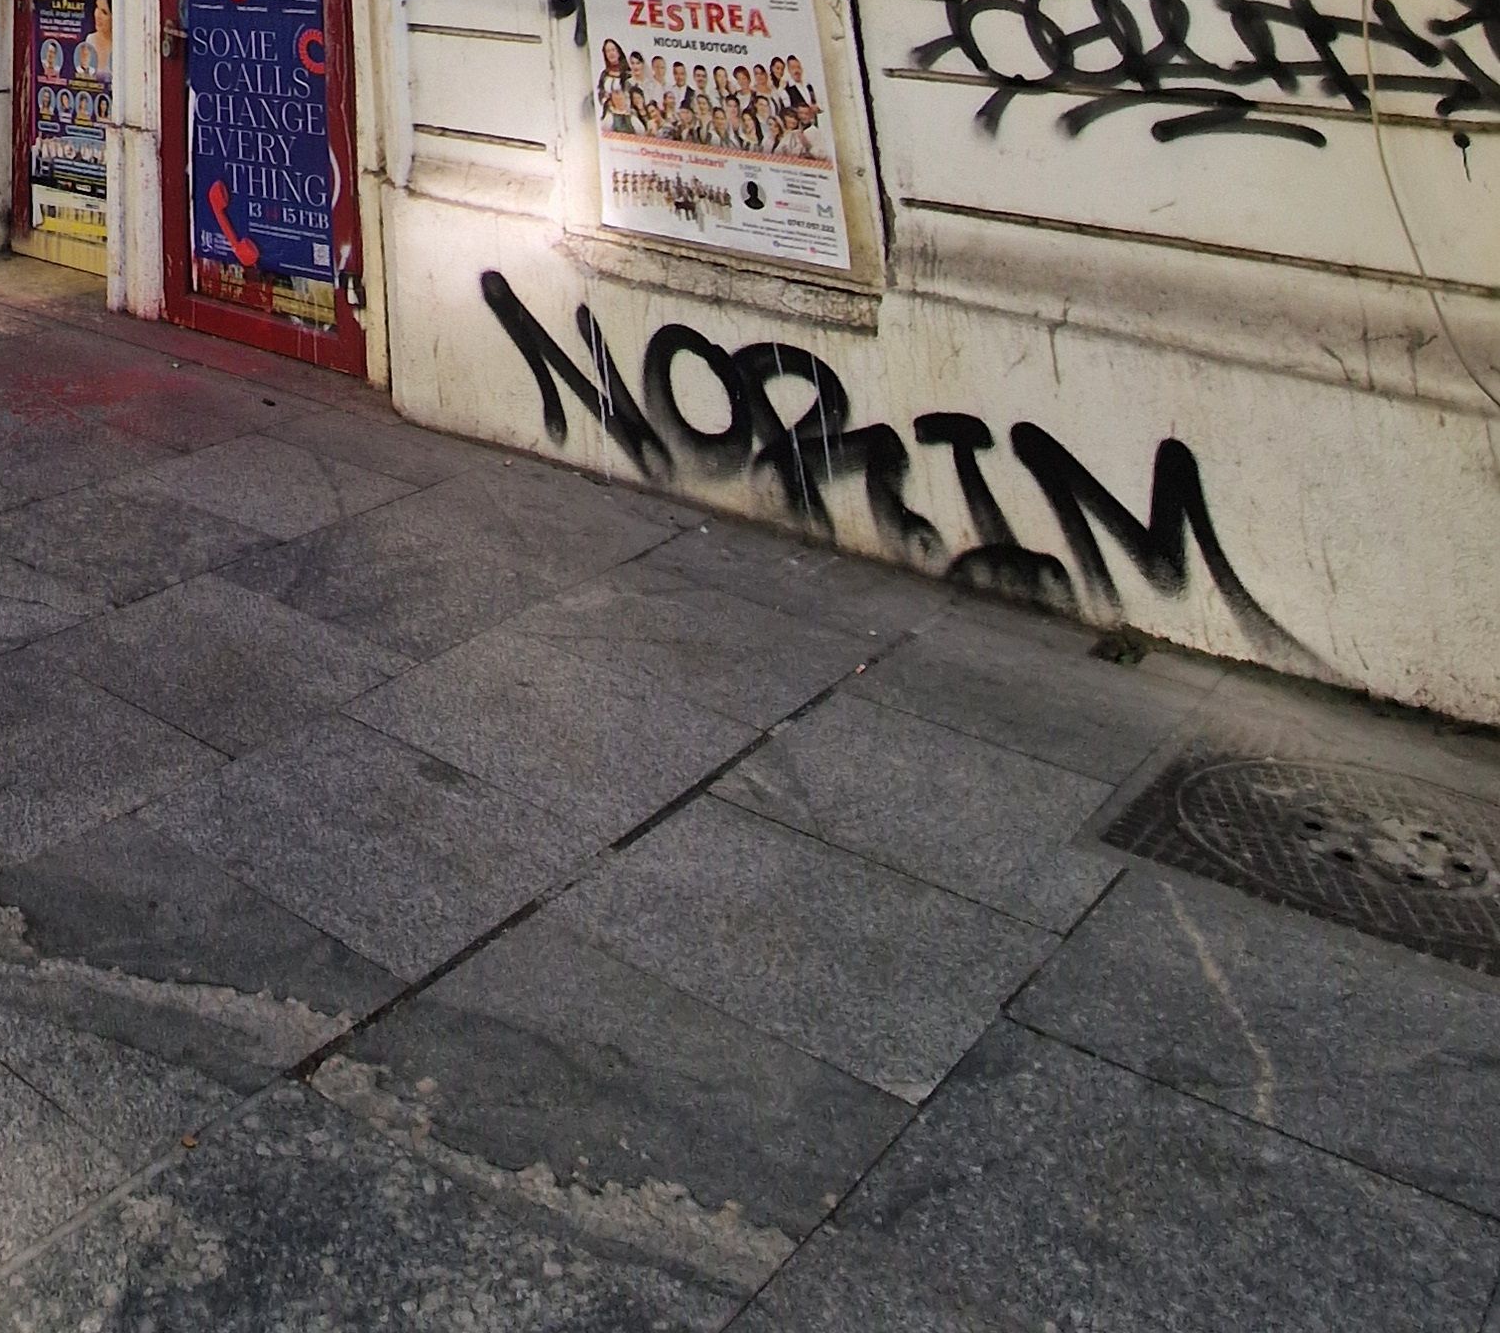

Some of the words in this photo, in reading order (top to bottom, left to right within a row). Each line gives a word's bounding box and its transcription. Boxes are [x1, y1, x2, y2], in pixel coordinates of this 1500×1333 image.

[192, 27, 278, 61] SOME
[653, 36, 697, 51] NICOLAE
[699, 40, 748, 56] BOTGROS
[213, 61, 311, 98] CALLS
[195, 92, 325, 135] CHANGE
[197, 125, 296, 167] EVERY
[225, 162, 327, 207] THING
[249, 201, 262, 218] 13
[283, 207, 297, 224] 15
[299, 209, 329, 229] FEB
